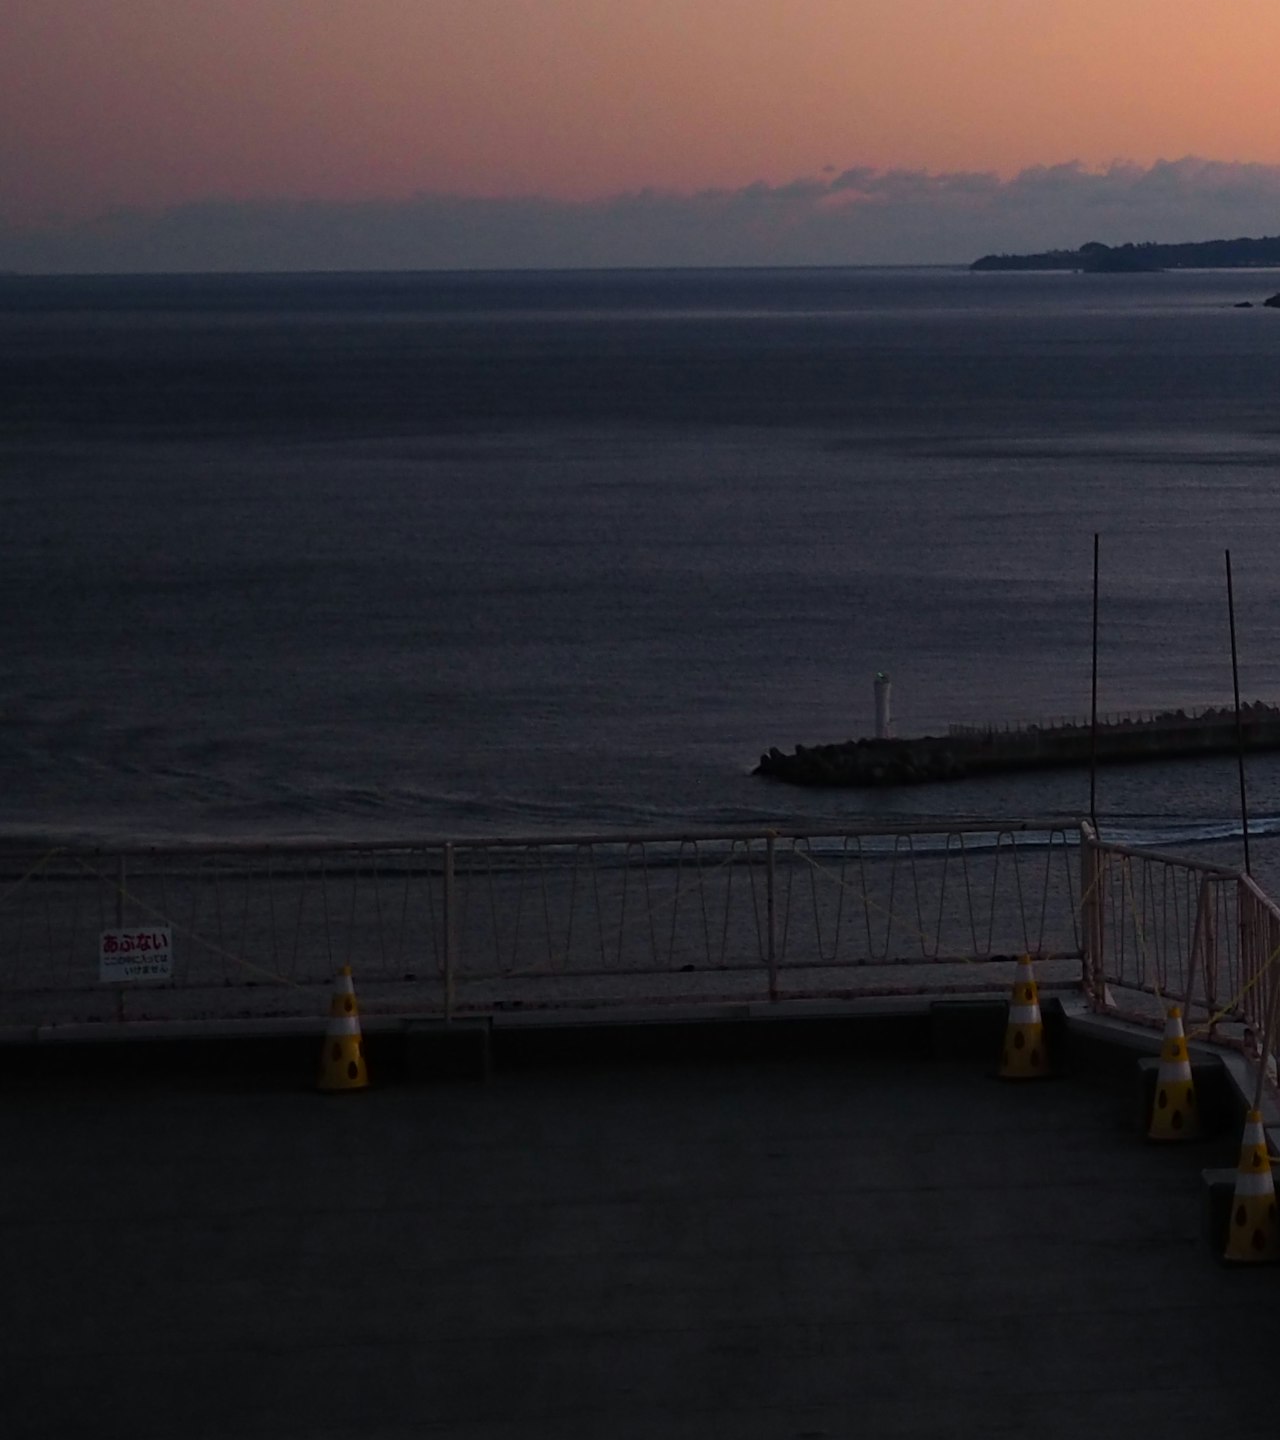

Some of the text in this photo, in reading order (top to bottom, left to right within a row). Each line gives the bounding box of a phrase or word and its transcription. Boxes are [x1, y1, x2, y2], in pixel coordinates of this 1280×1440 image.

[103, 933, 168, 953] あぶない
[124, 965, 168, 976] いけません
